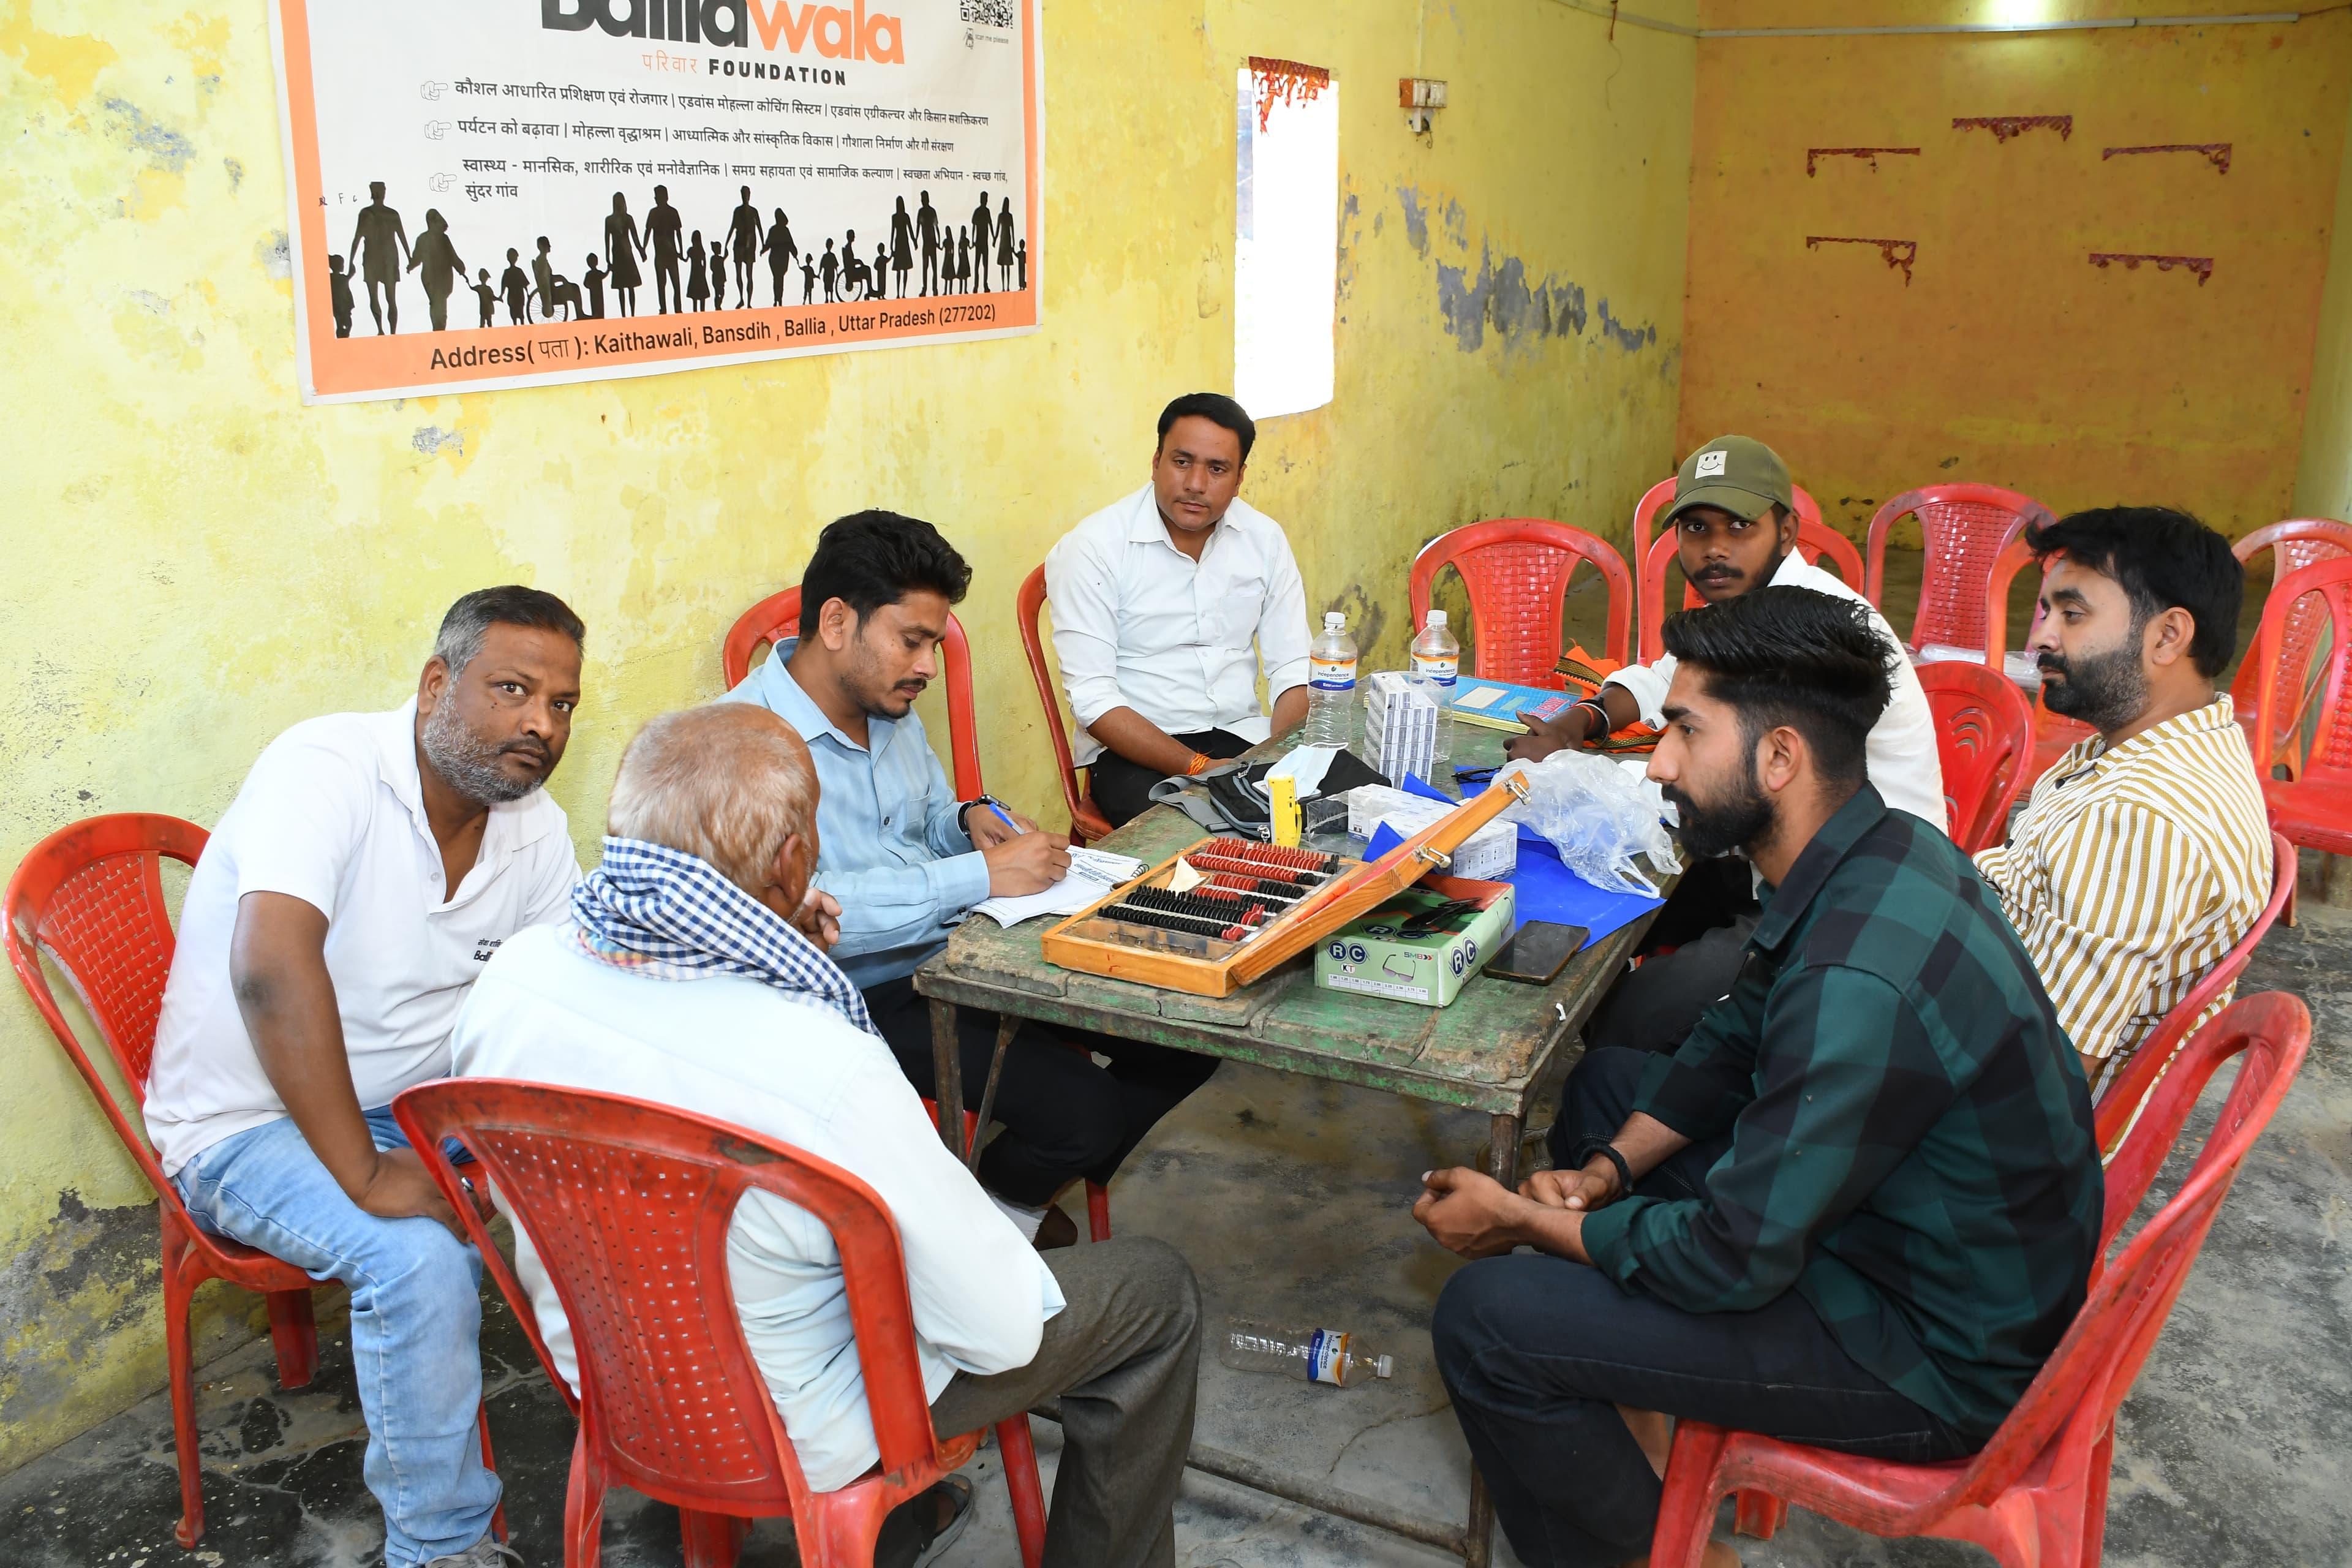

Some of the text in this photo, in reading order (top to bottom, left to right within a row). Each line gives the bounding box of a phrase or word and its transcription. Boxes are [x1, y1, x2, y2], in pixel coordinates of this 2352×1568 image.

[642, 50, 698, 74] परिवार
[709, 58, 846, 86] FOUNDATION
[454, 78, 497, 96] कौशल
[502, 82, 556, 99] आधारित
[559, 85, 605, 102] प्रशिक्षण
[608, 88, 626, 106] एवं
[629, 89, 668, 105] रोजगार
[678, 94, 714, 110] एडवांस
[717, 95, 754, 112] मोहल्ला
[756, 97, 789, 113] कोचिंग
[792, 99, 822, 115] सिस्टम
[831, 104, 861, 118] एडवांस
[864, 105, 905, 120] एग्रीकल्चर
[908, 108, 922, 121] और
[924, 108, 947, 123] किसान
[458, 116, 497, 134] पर्यटन
[500, 118, 518, 135] को
[572, 121, 614, 140] मोहल्ला
[672, 127, 729, 142] आध्यात्मिक
[732, 129, 750, 143] और
[753, 130, 800, 149] सांस्कृतिक
[802, 132, 833, 146] विकास
[842, 134, 873, 148] गौशाला
[875, 135, 903, 149] निर्माण
[906, 137, 919, 150] और
[931, 138, 954, 152] संरक्षण
[462, 159, 507, 172] स्वास्थ्य
[522, 157, 578, 176] मानसिक,
[584, 158, 632, 174] शारीरिक
[636, 160, 653, 177] एवं
[657, 160, 720, 175] मनोवैज्ञानिक
[731, 165, 756, 176] समग्र
[760, 166, 796, 178] सहायता
[799, 164, 813, 179] एवं
[816, 164, 859, 178] सामाजिक
[862, 168, 894, 178] कल्याण
[903, 170, 930, 179] स्वच्छता
[933, 167, 963, 180] अभियान
[972, 172, 991, 181] स्वच्छ
[465, 181, 518, 202] सुंदर गांव
[431, 340, 534, 369] Address(
[538, 340, 568, 358] पता
[595, 327, 697, 354] Kaithawali,
[703, 322, 771, 344] Bansdih
[785, 317, 826, 337] Ballia
[839, 315, 876, 332] Uttar
[880, 309, 935, 329] Pradesh
[940, 304, 995, 326] (277202)
